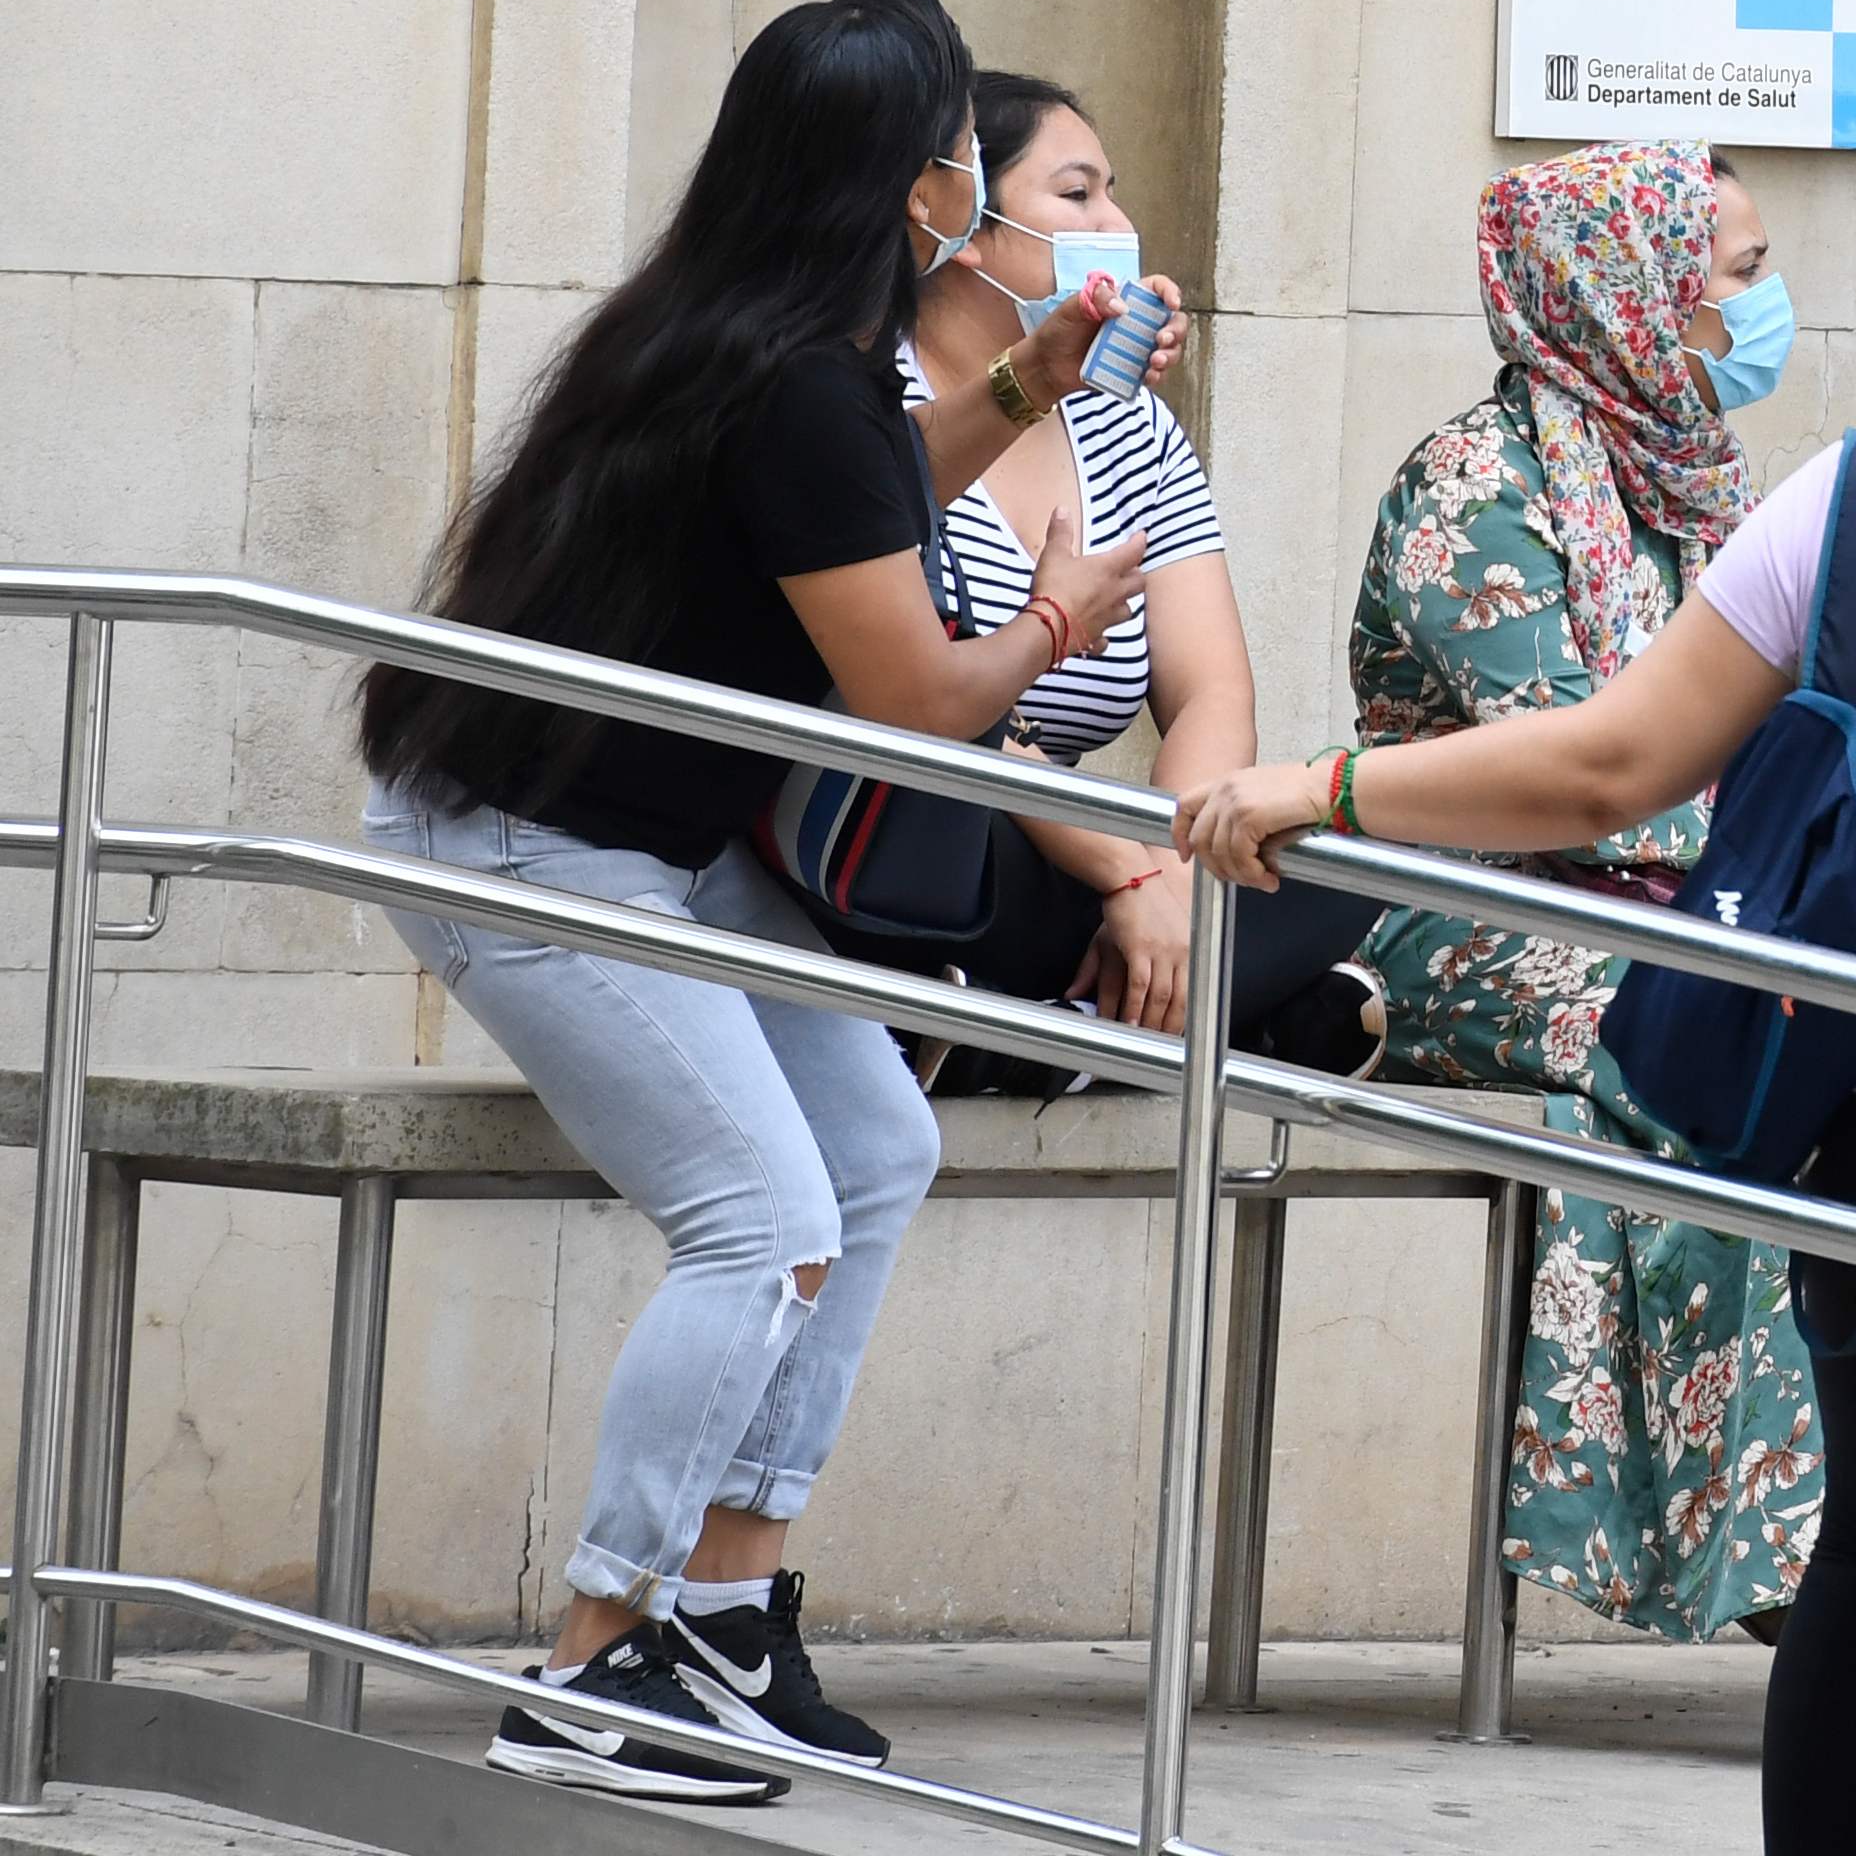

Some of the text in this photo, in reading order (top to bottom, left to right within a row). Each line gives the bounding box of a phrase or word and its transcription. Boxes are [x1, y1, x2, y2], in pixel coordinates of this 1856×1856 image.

[1587, 58, 1813, 88] Generalitat de Catalunya
[1587, 84, 1797, 109] Departament de Salut
